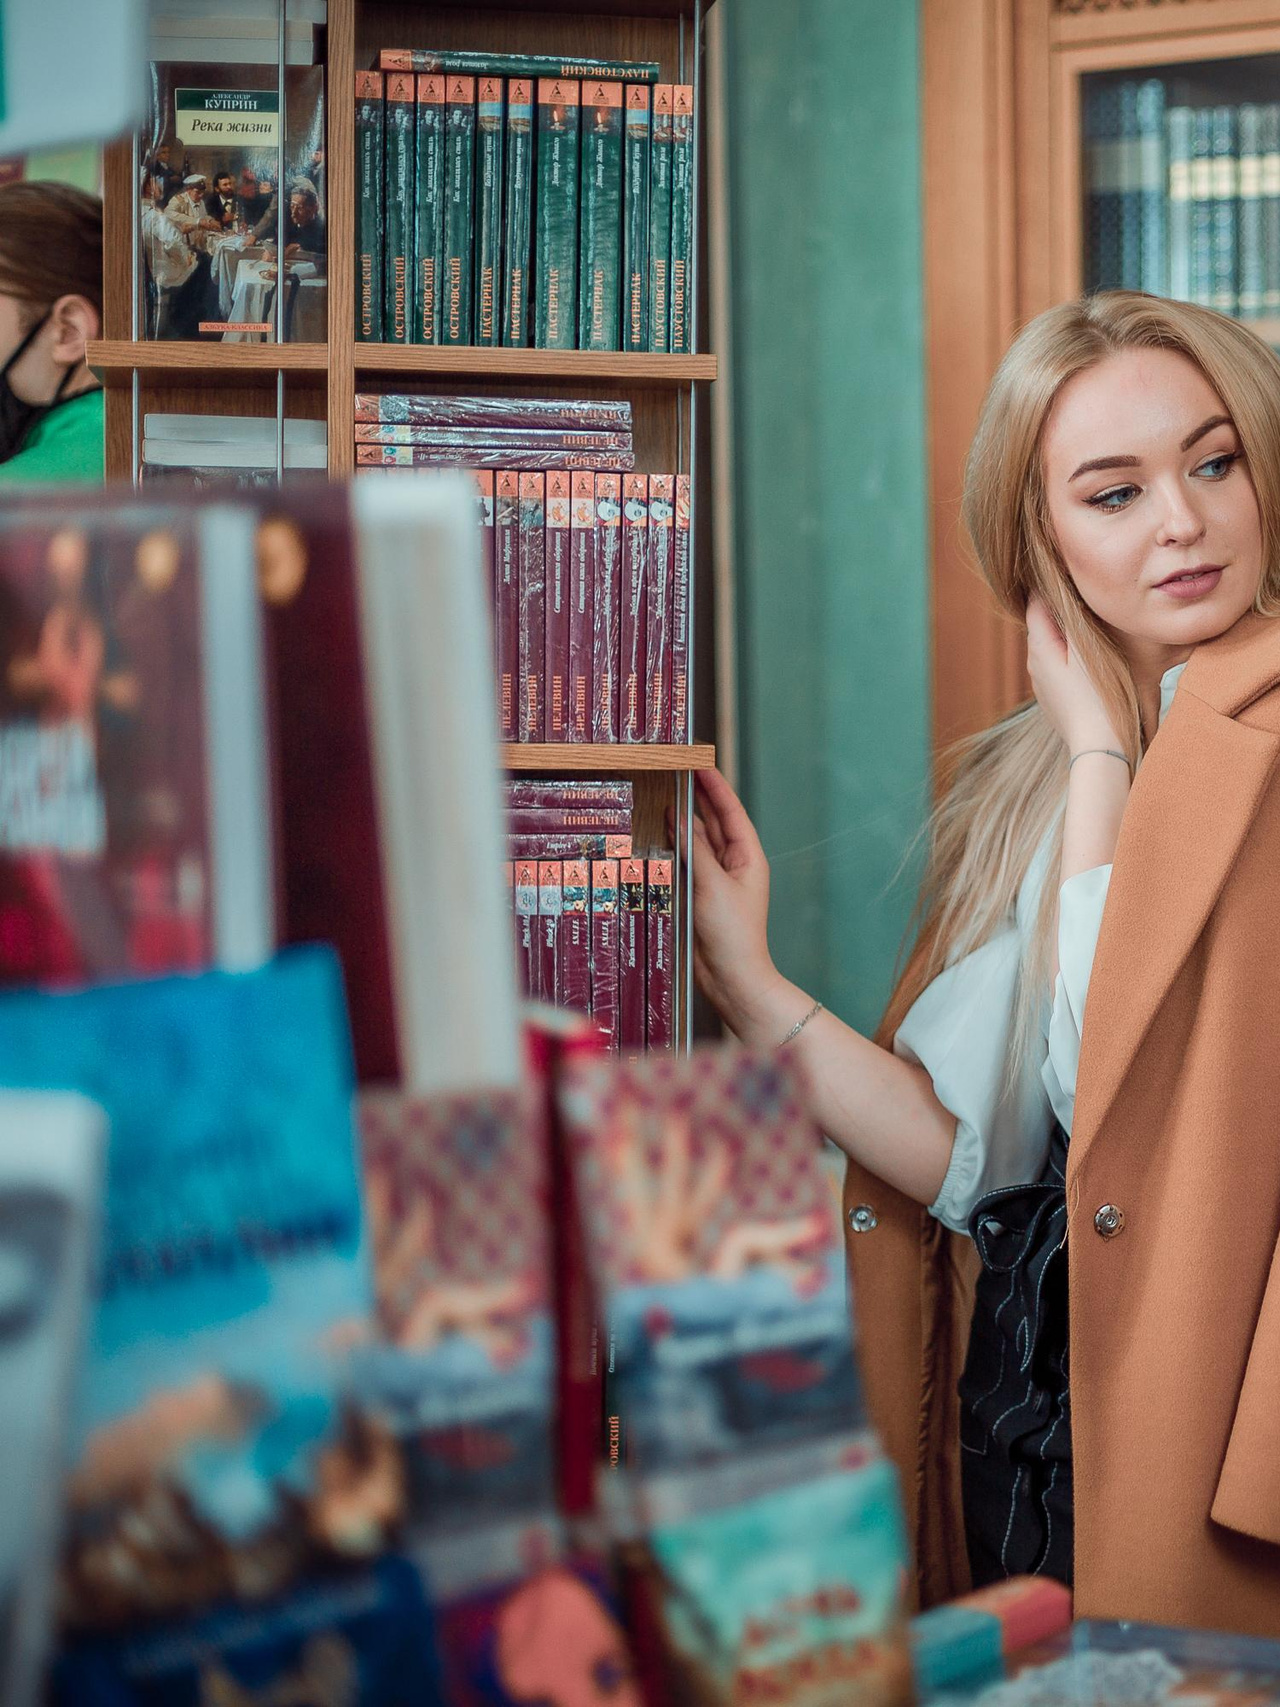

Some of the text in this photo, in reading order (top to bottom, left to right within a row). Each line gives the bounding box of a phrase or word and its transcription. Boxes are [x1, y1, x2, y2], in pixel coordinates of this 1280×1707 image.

[205, 99, 258, 110] КУПРИН
[561, 64, 649, 79] ПАУСТОВСКИЙ
[192, 119, 272, 134] Река жизни
[362, 253, 372, 335] ОСТРОВСКИЙ
[395, 257, 404, 338] ОСТРОВСКИЙ
[423, 257, 433, 339] ОСТРОВСКИЙ
[450, 257, 460, 338] ОСТРОВСКИЙ
[482, 267, 492, 338] ПАСТЕРНАК
[512, 269, 521, 339] ПАСТЕРНАК
[549, 269, 559, 339] ПАСТЕРНАК
[593, 270, 603, 340] ПАСТЕРНАК
[632, 273, 641, 343] ПАСТЕРНАК
[654, 260, 666, 346] ПАУСТОВСКИЙ
[674, 260, 684, 347] ПАУСТОВСКИЙ
[503, 673, 511, 729] ПЕЛЕВИН
[553, 676, 562, 730] ПЕЛЕВИН
[577, 676, 585, 731] ПЕЛЕВИН
[563, 816, 618, 825] ПЕЛЕВИН
